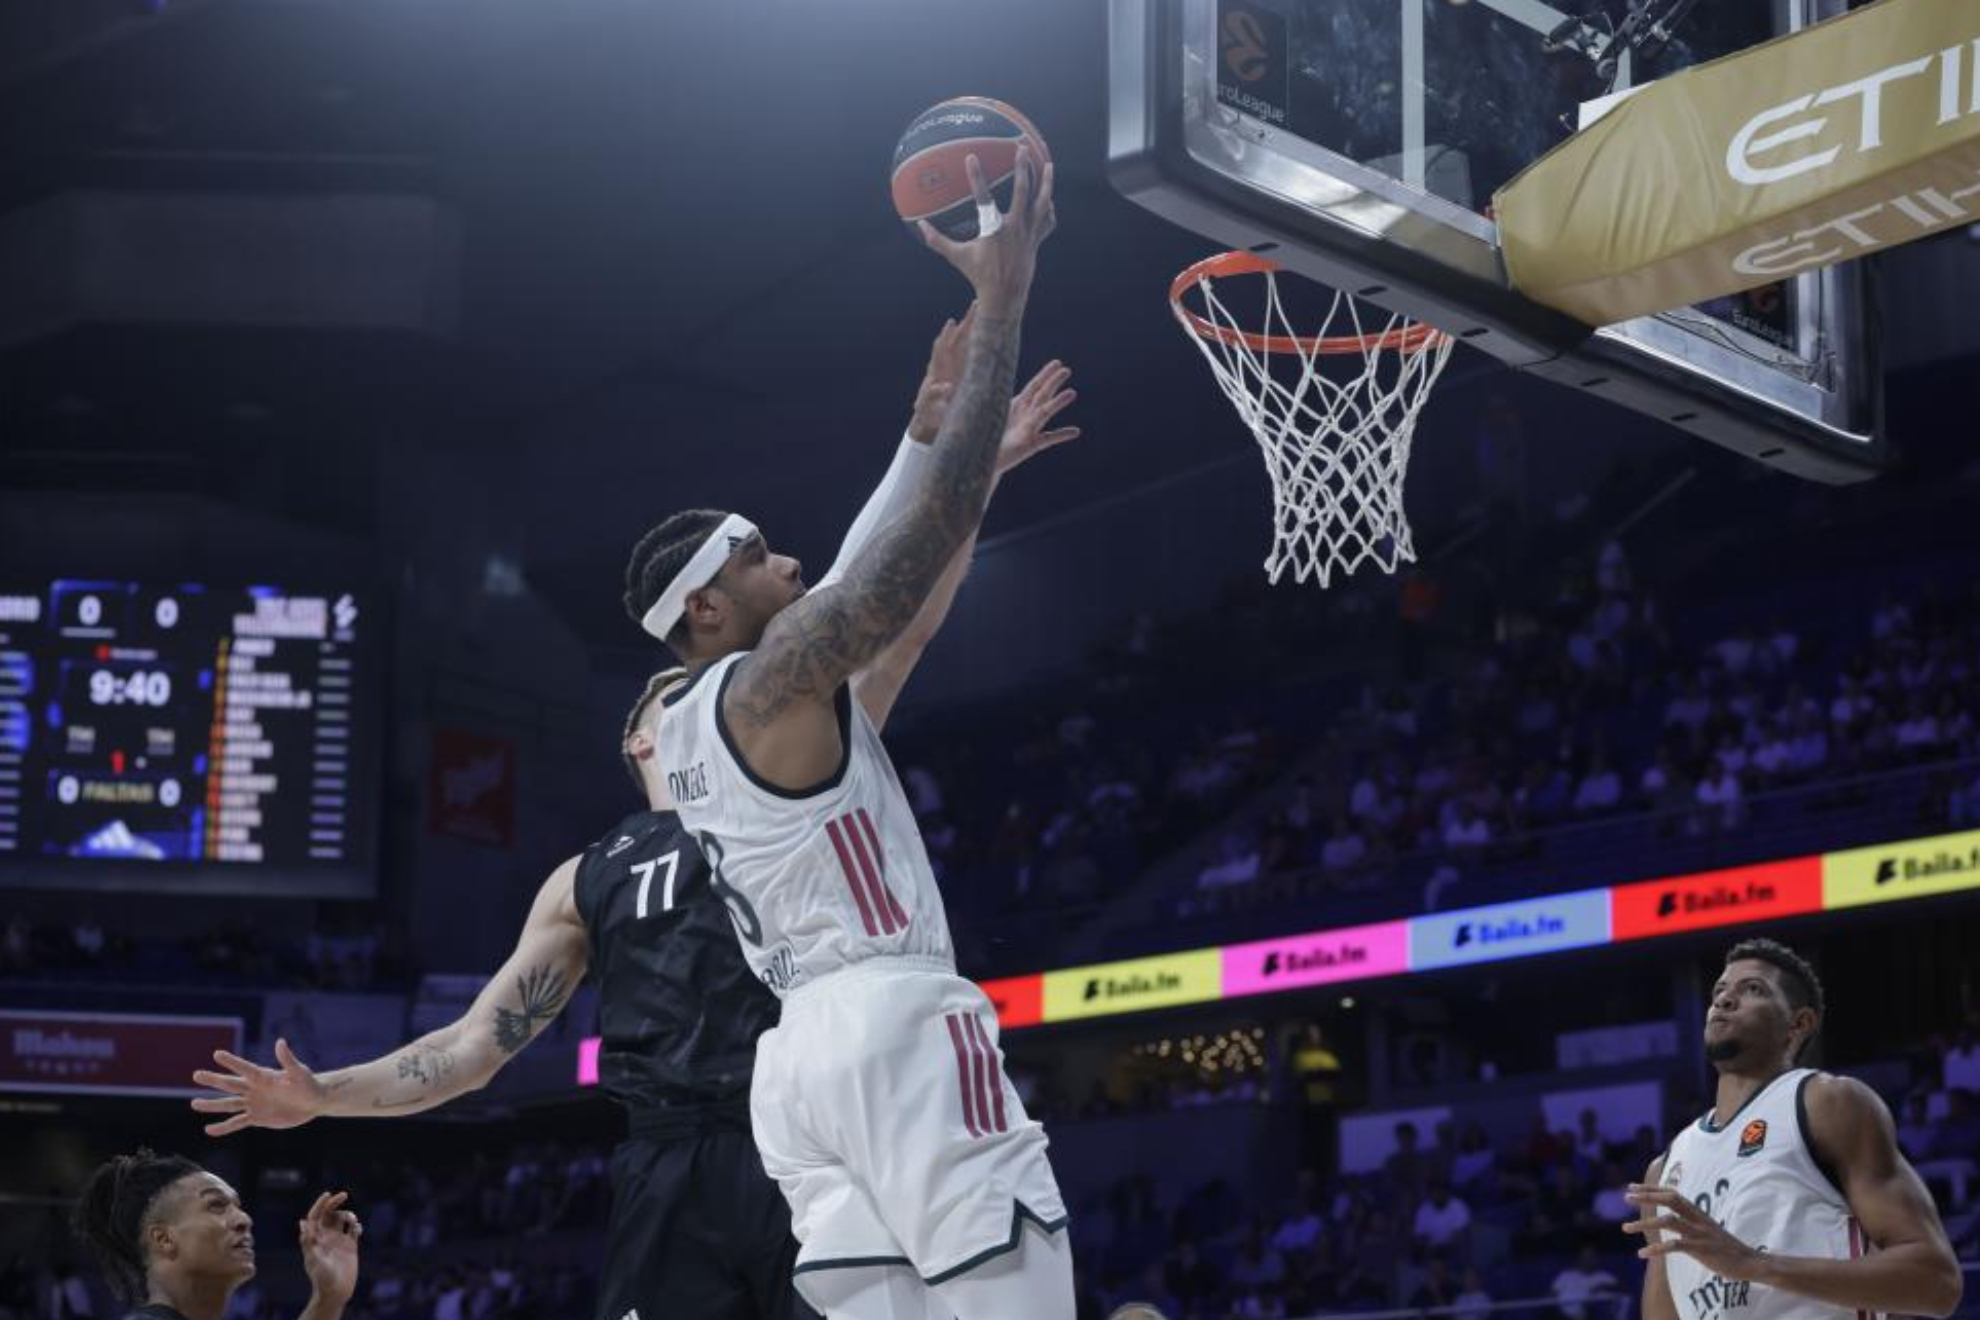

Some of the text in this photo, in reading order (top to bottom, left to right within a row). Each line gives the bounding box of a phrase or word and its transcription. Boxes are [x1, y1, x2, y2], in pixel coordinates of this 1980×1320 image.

[1219, 83, 1285, 122] roLeague
[79, 596, 101, 625] 0
[156, 598, 178, 628] 0
[90, 670, 170, 705] 9:40
[58, 776, 79, 804] 0
[159, 779, 180, 806] 0
[630, 849, 679, 919] 77
[1684, 884, 1775, 912] Baila.fm
[1479, 917, 1564, 943] Baila.fm
[1287, 945, 1367, 973] Baila.fm
[1106, 973, 1180, 998] Baila.fm
